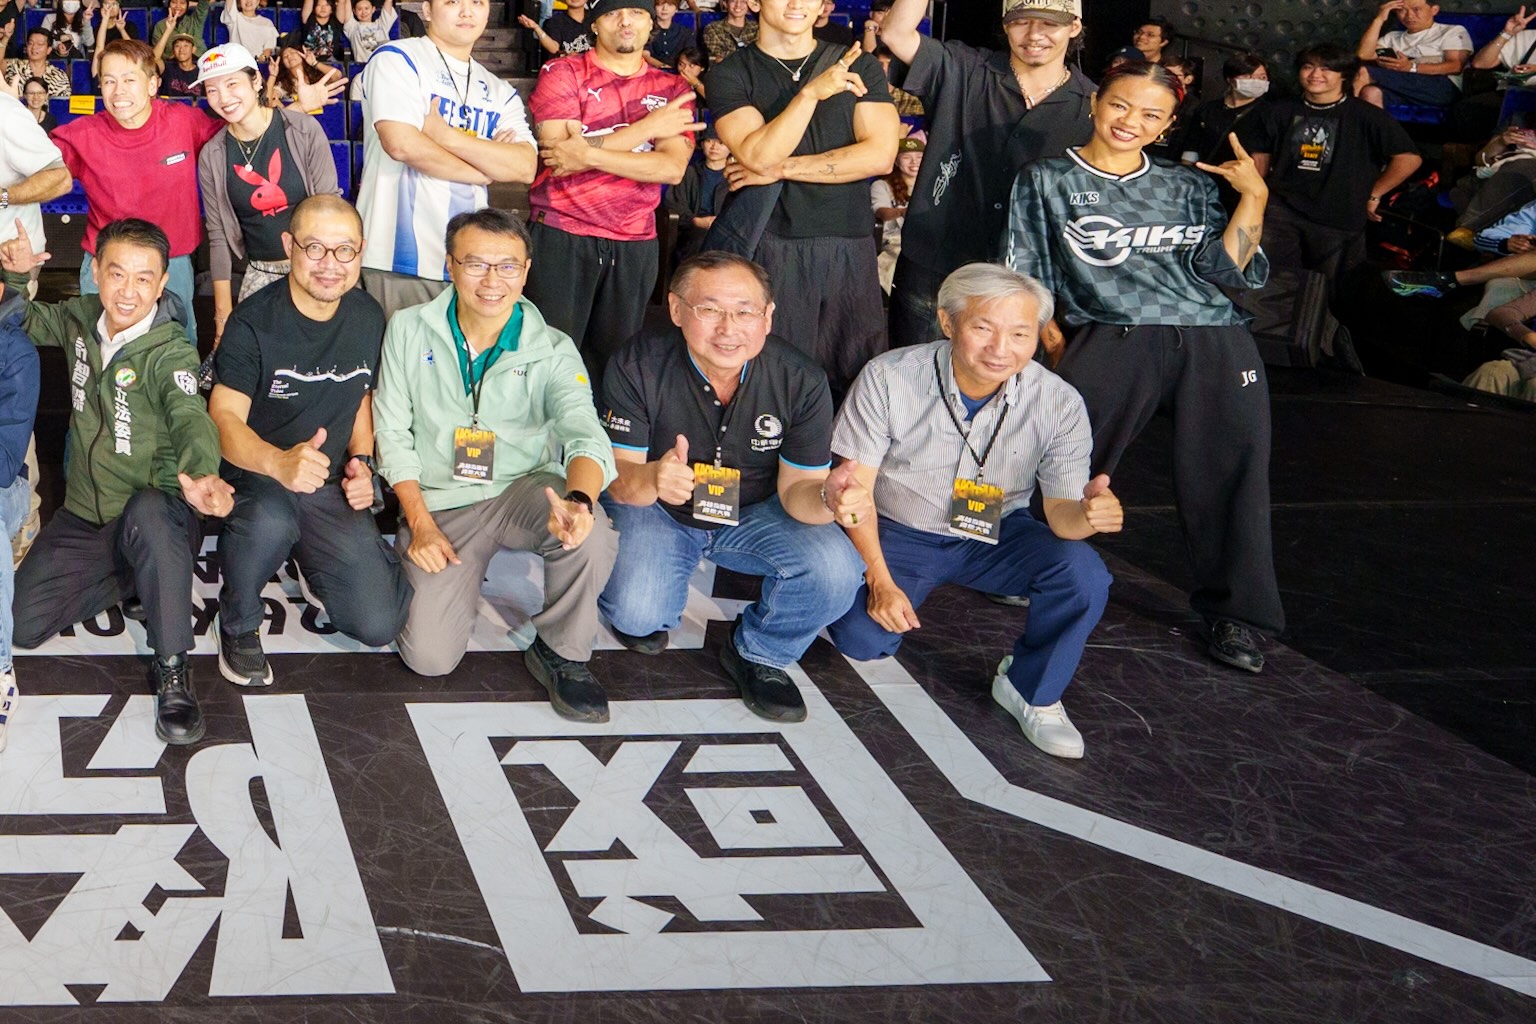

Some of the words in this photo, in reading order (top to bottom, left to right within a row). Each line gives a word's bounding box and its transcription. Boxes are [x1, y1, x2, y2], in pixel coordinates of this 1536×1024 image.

[1069, 192, 1100, 206] KIKS
[1090, 225, 1206, 251] KIKS
[1241, 370, 1258, 387] JG
[114, 386, 132, 456] 立法委員
[466, 447, 482, 458] VIP
[707, 483, 725, 496] VIP
[967, 498, 986, 513] VIP
